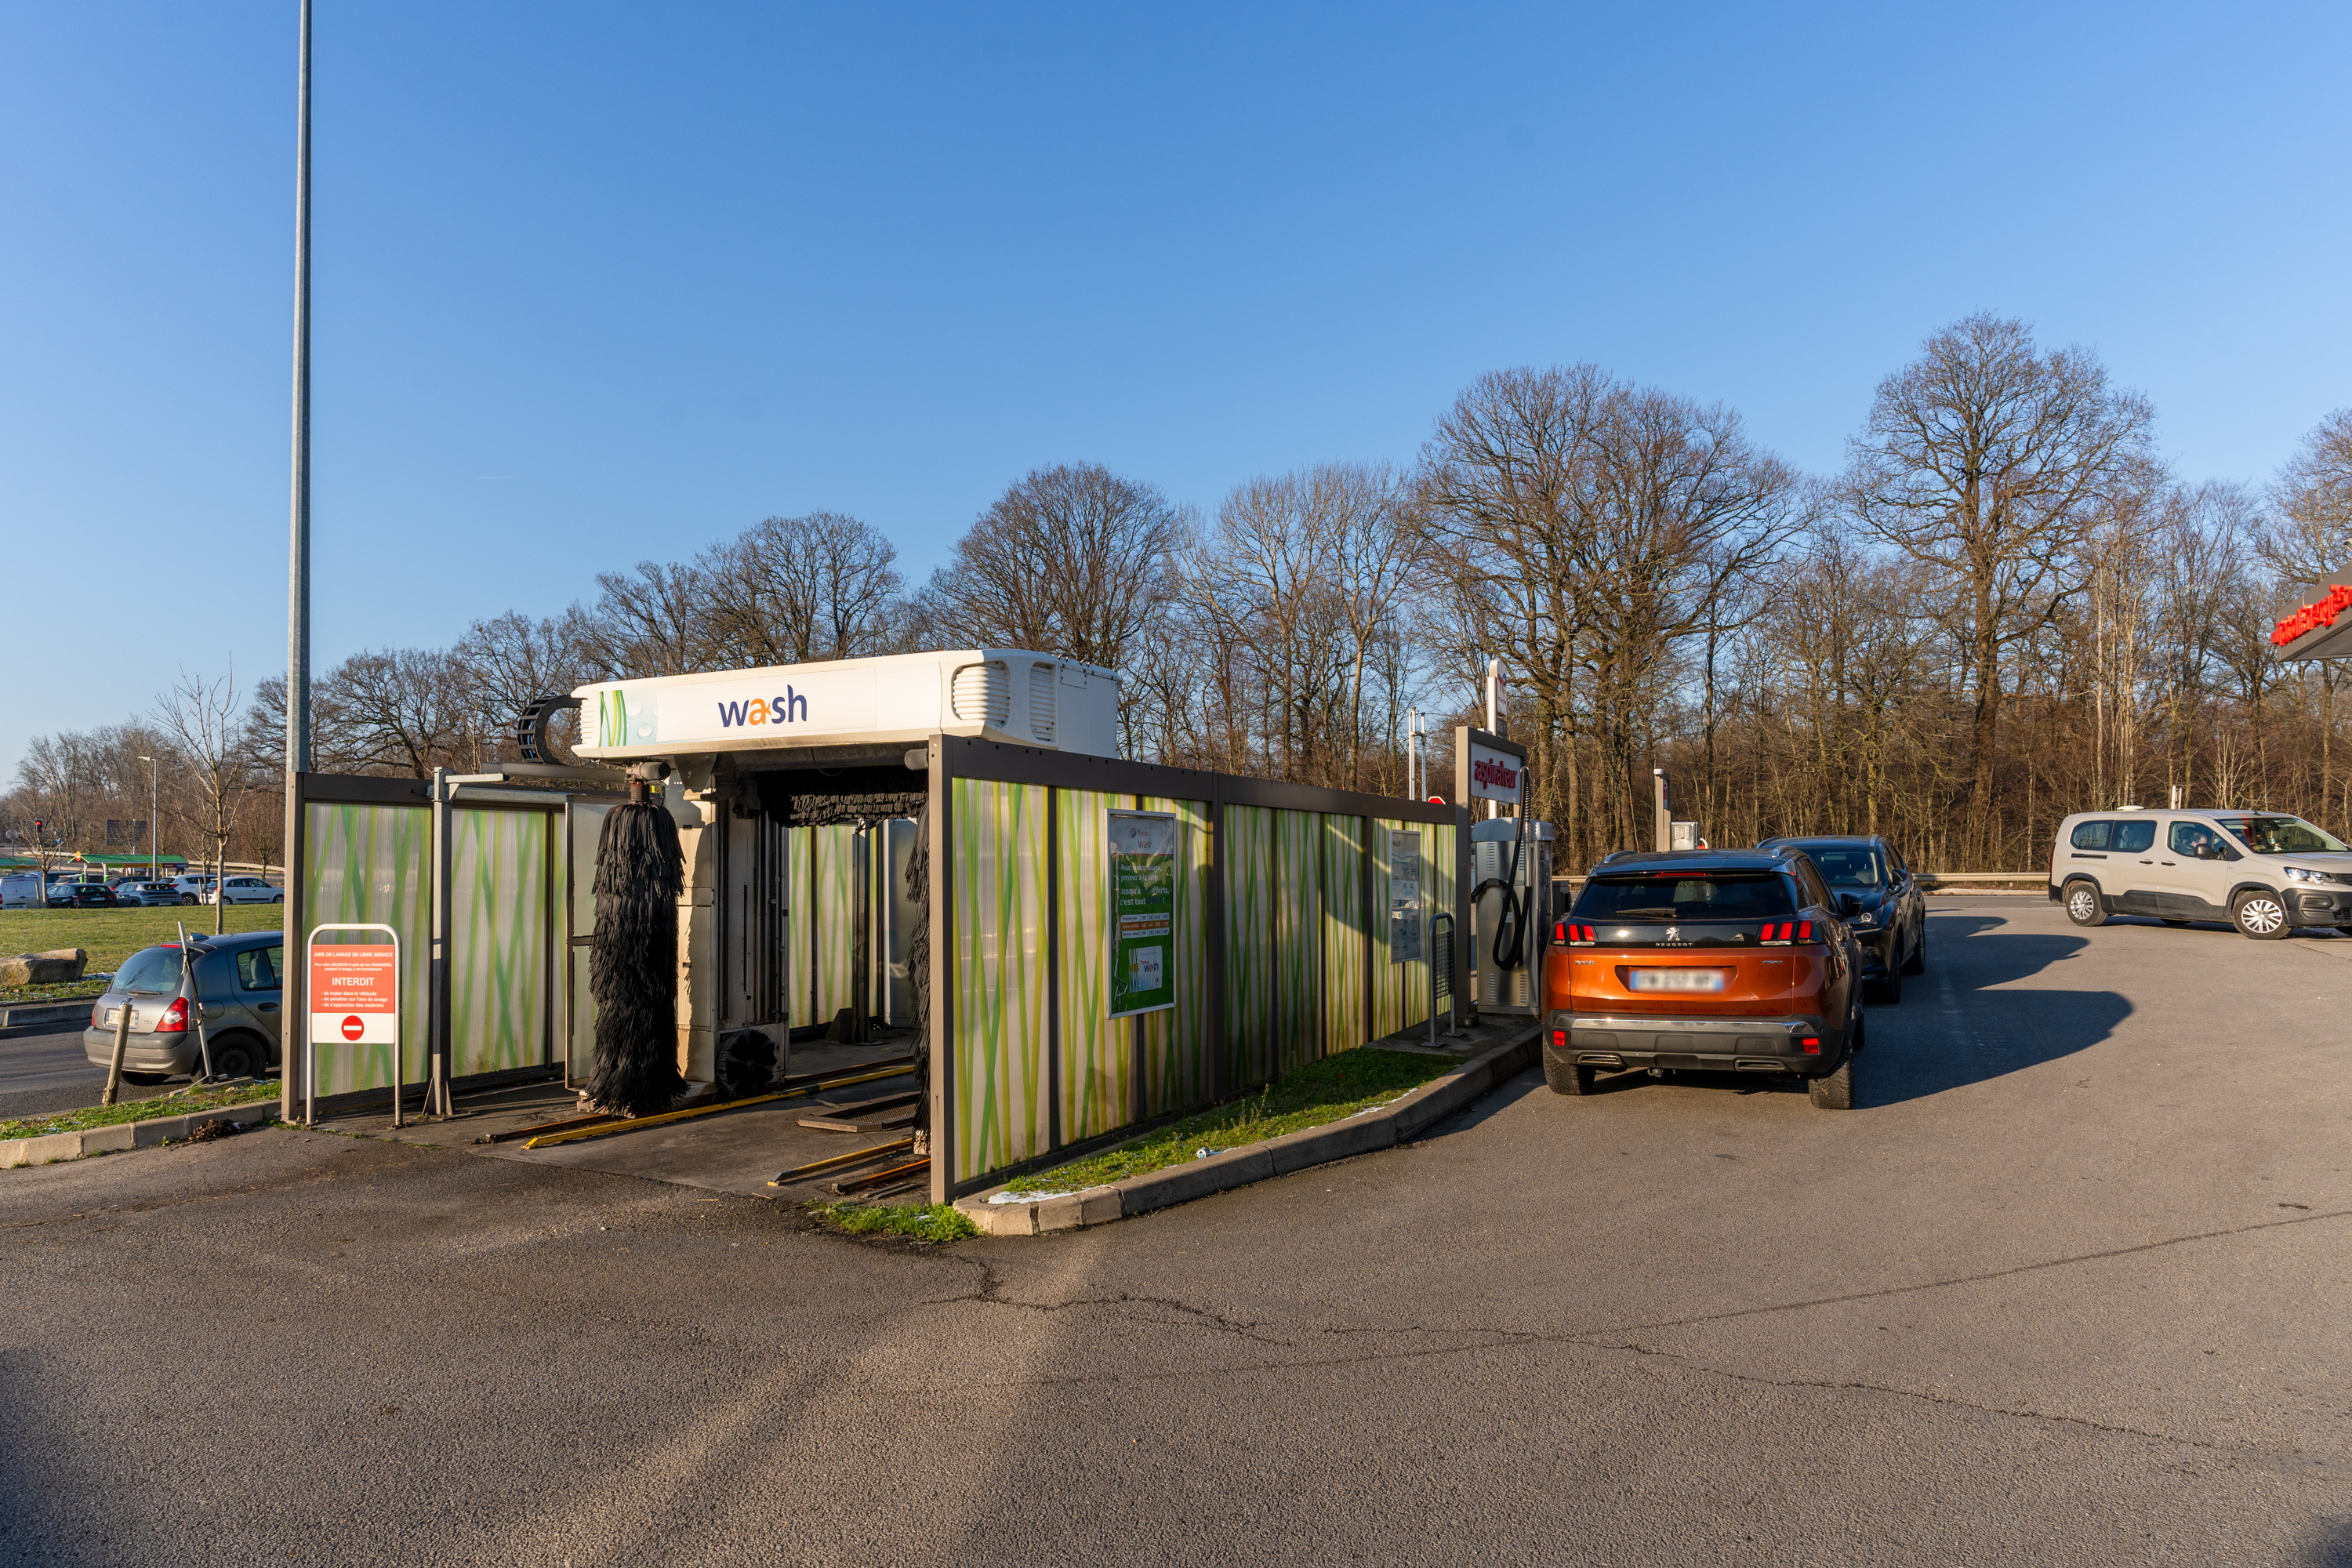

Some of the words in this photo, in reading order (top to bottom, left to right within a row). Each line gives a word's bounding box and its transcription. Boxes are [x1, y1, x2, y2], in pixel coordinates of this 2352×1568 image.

[718, 684, 807, 728] wash
[1475, 758, 1517, 789] aspirateur
[1144, 960, 1159, 972] wash
[332, 977, 374, 985] INTERDIT
